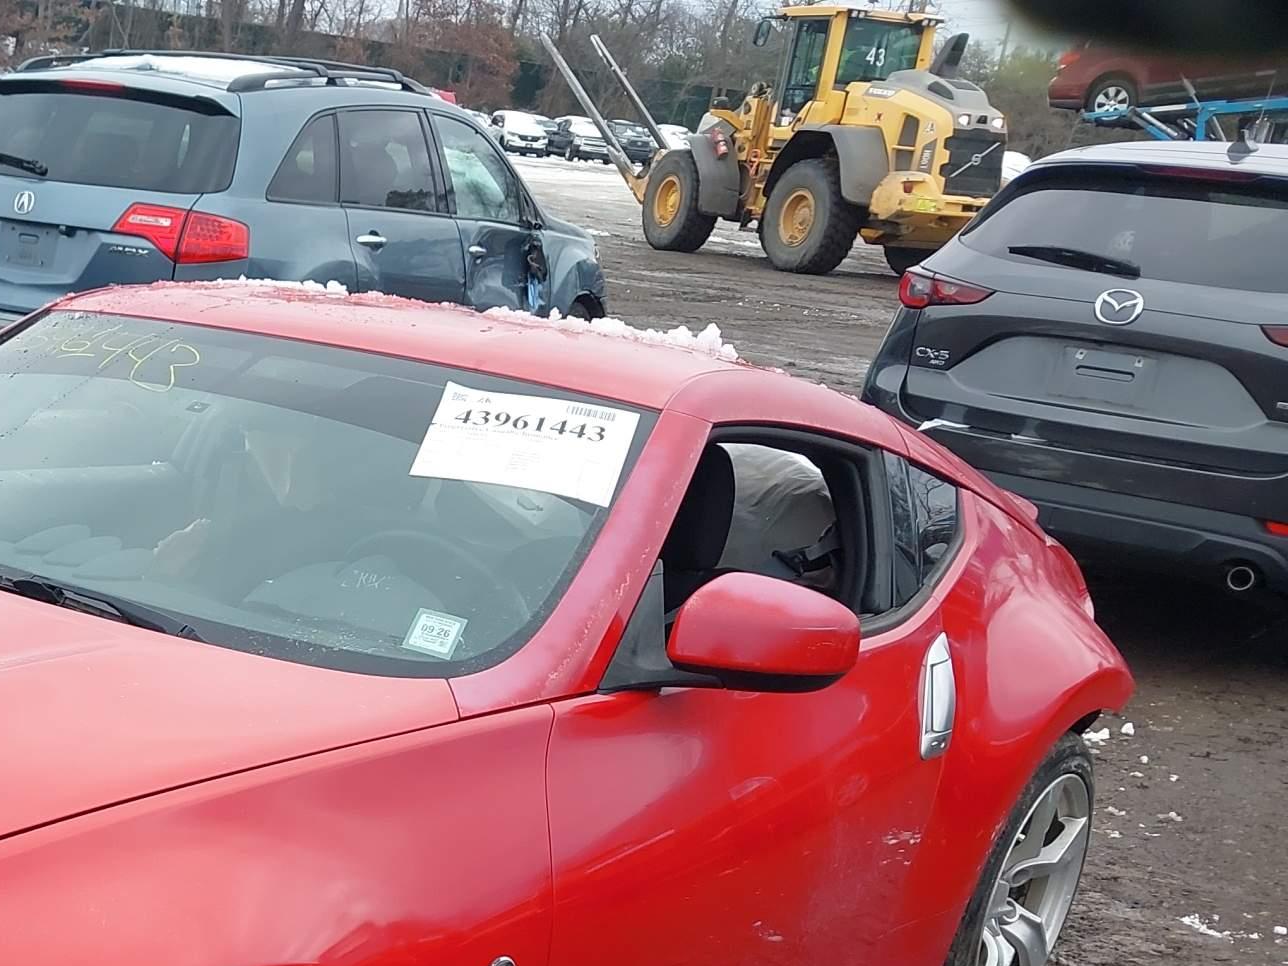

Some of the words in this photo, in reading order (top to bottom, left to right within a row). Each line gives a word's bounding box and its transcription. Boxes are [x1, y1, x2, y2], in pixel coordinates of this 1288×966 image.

[865, 47, 885, 66] 43
[915, 346, 950, 360] CX-5
[454, 409, 606, 443] 43961443
[421, 623, 435, 634] 09
[436, 627, 451, 638] 26
